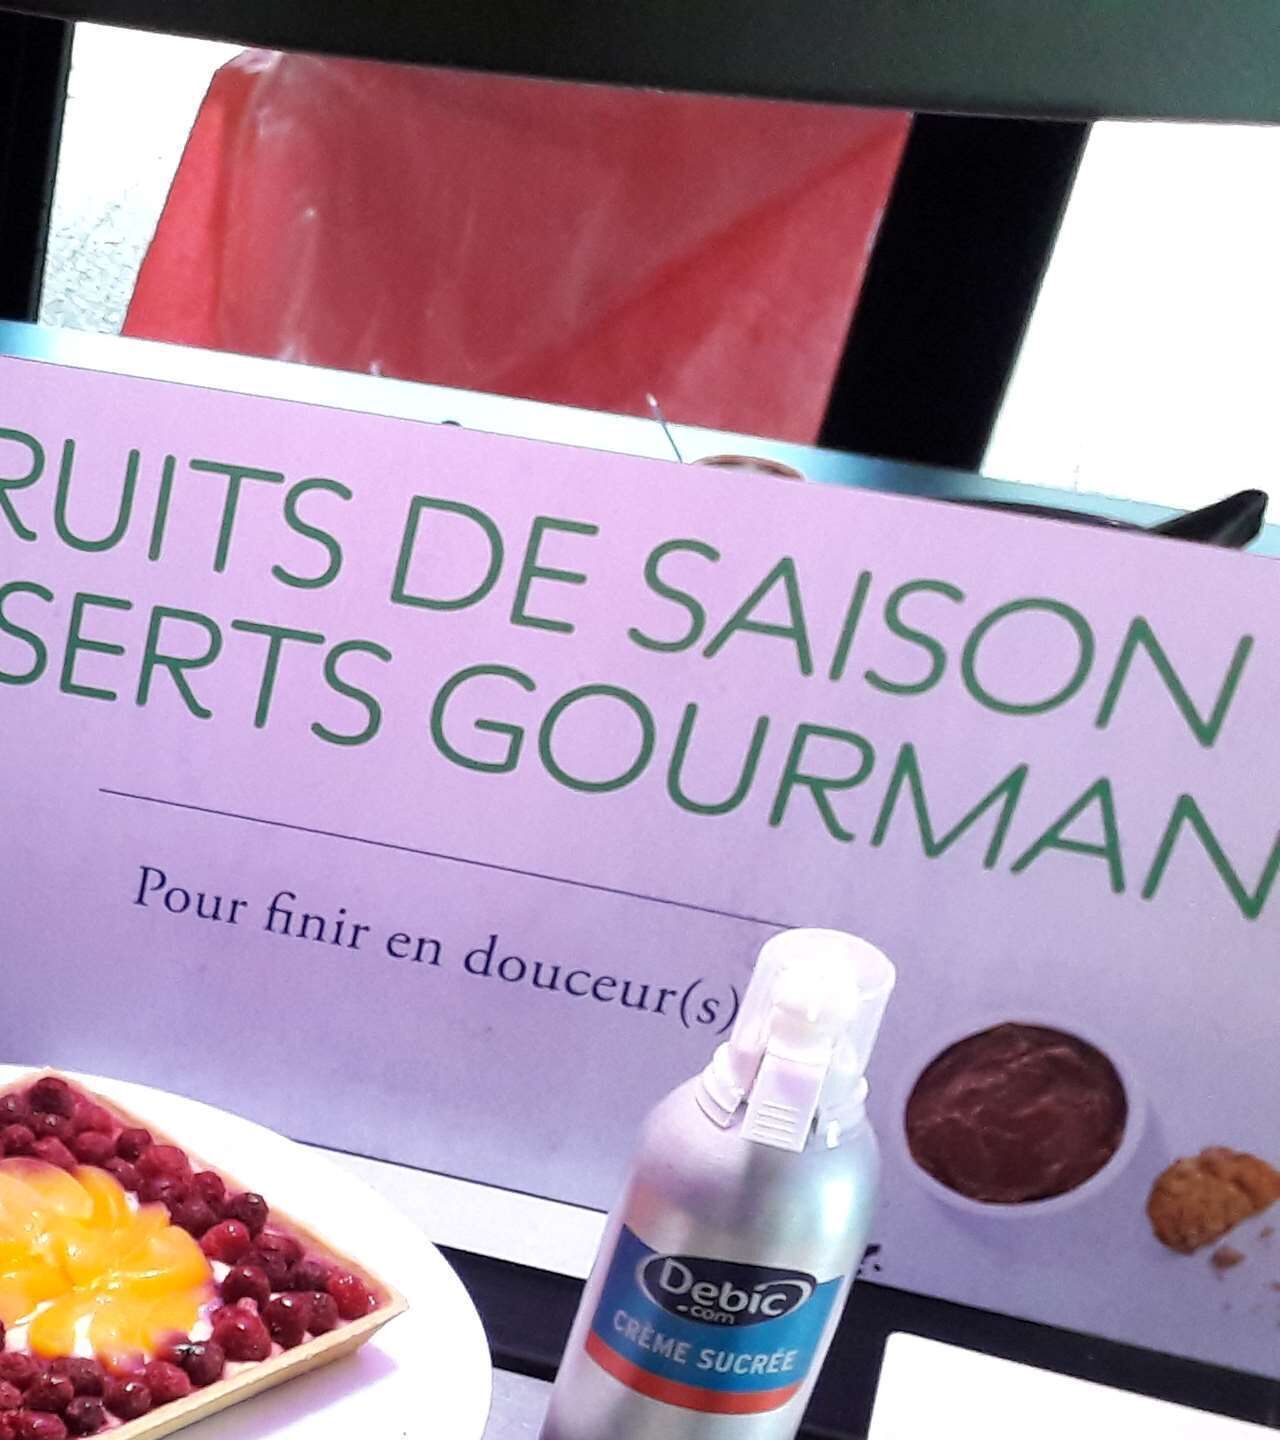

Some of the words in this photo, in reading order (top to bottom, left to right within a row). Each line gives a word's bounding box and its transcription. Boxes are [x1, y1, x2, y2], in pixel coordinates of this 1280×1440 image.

[390, 495, 599, 633] DE
[628, 538, 1254, 748] SAISON
[429, 663, 1280, 920] GOURMAN
[134, 866, 248, 924] Pour
[262, 891, 371, 952] finir
[385, 929, 442, 966] en
[463, 935, 741, 1035] douceur(s)
[612, 1309, 692, 1364] CRÈME
[696, 1348, 800, 1376] SUCRÉE
[658, 1258, 788, 1316] Debic
